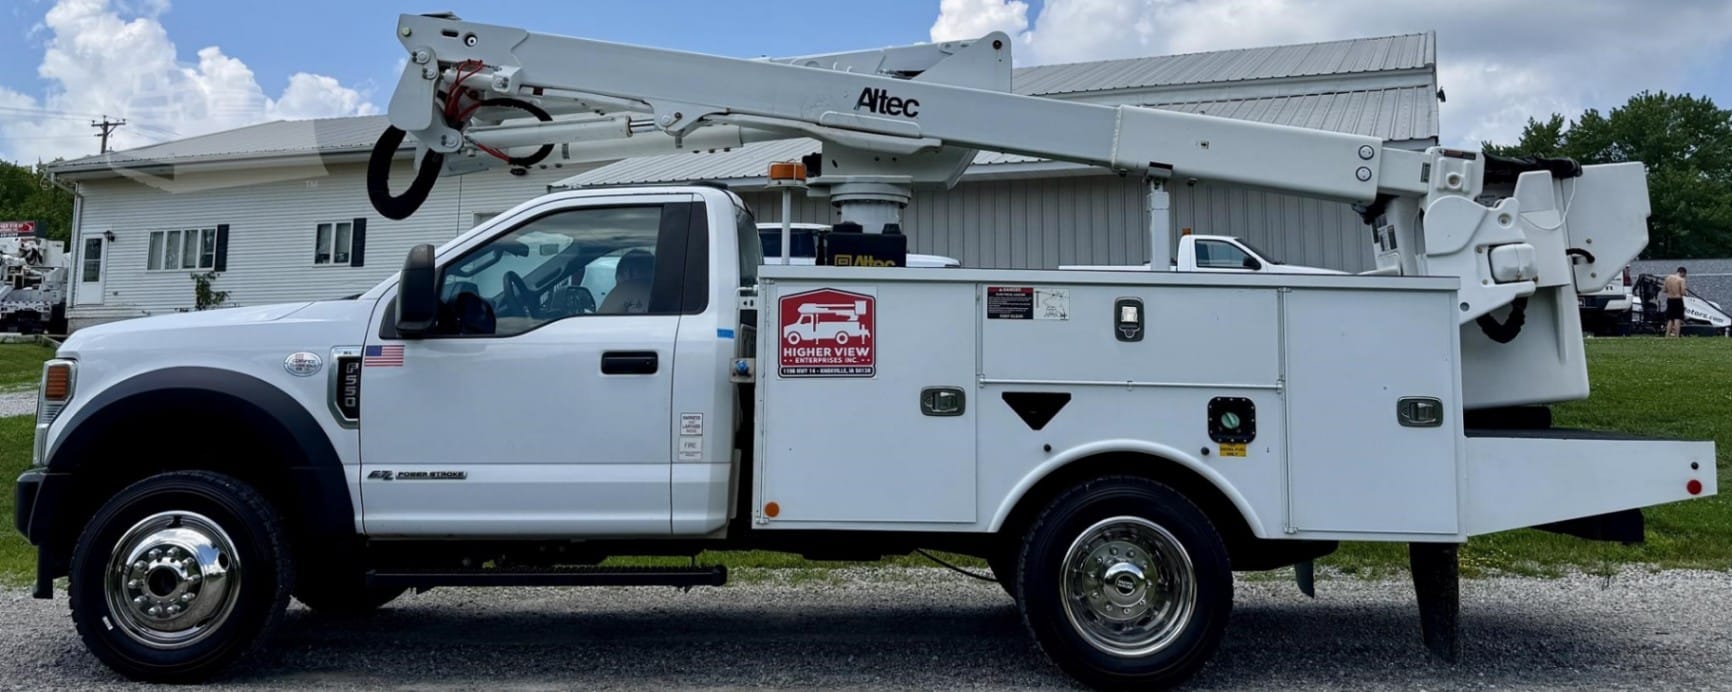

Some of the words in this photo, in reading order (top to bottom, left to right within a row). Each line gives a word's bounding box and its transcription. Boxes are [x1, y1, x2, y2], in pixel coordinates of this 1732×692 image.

[853, 87, 920, 118] Altec
[783, 347, 831, 357] HIGHER
[834, 347, 870, 356] VIEW
